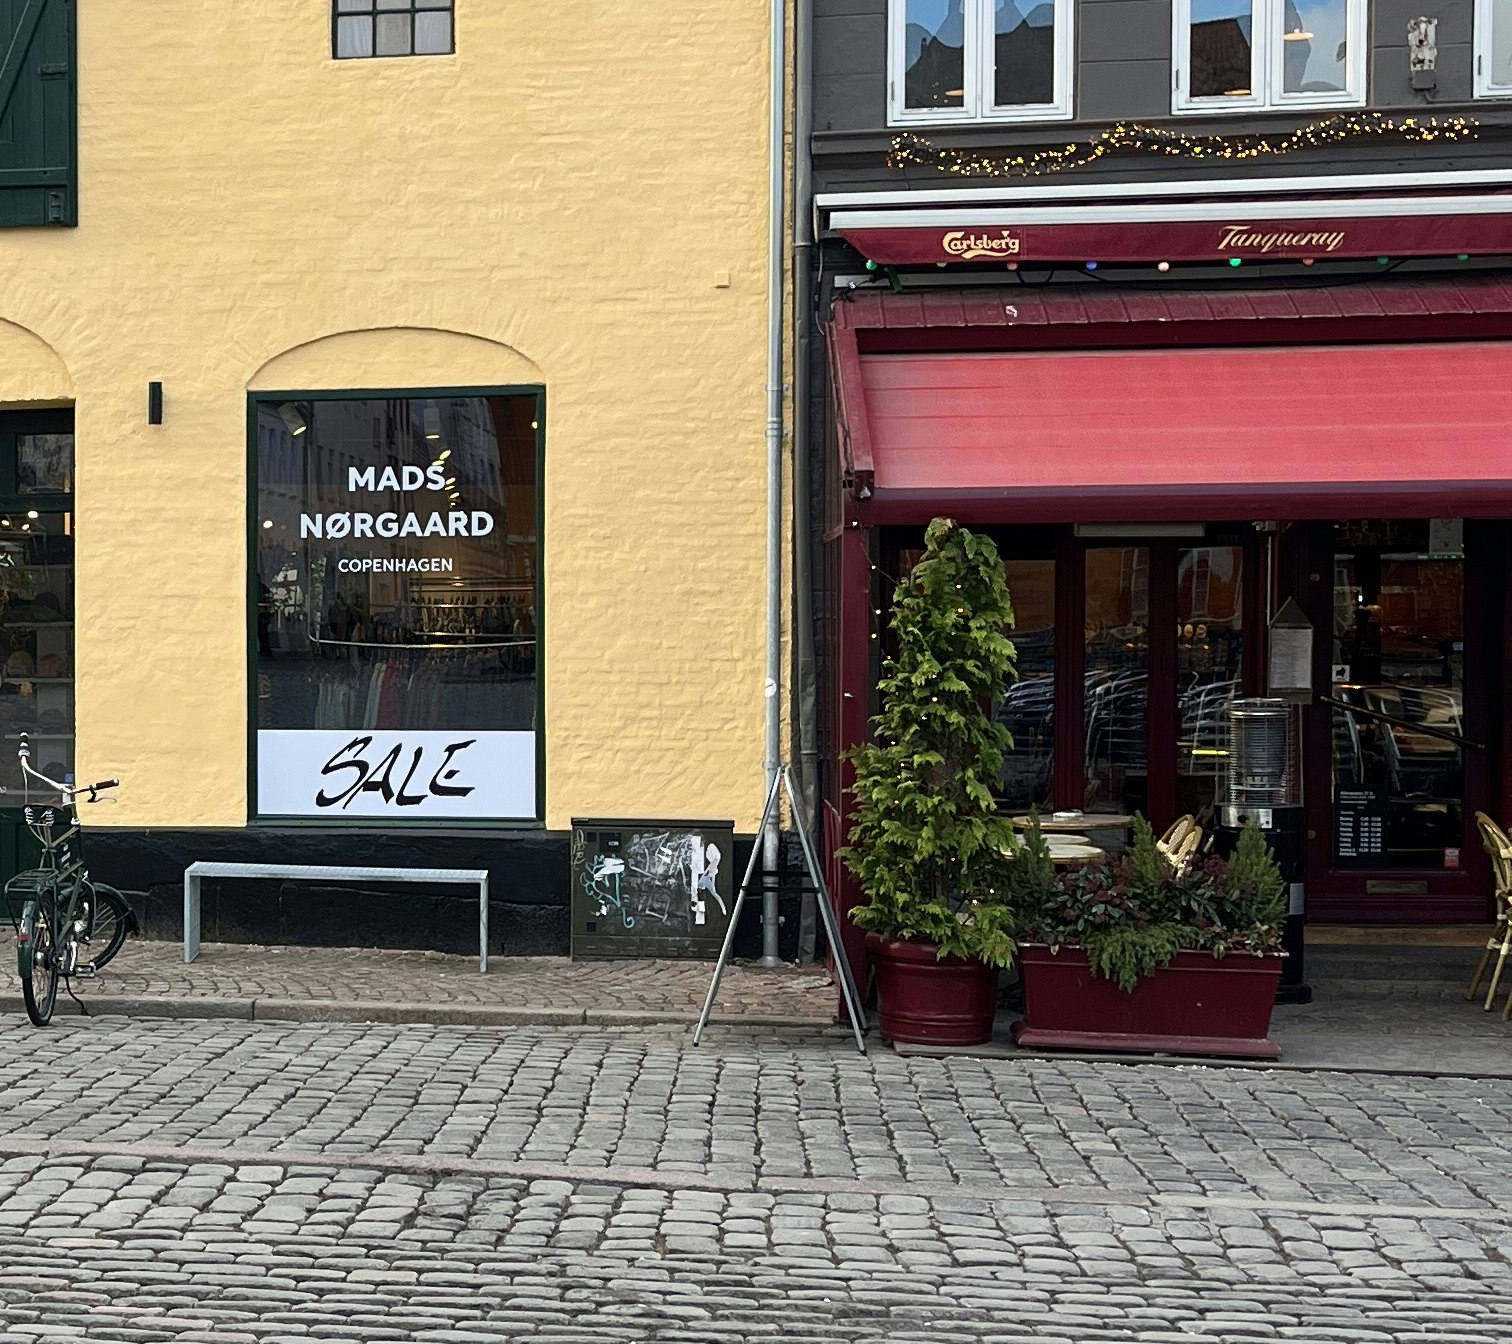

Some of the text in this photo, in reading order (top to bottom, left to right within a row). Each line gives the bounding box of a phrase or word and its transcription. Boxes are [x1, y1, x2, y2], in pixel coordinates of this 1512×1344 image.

[942, 230, 1020, 260] Carlsberg
[1217, 225, 1345, 253] Tanqueray
[348, 465, 445, 492] MADS
[299, 510, 494, 540] NØRGAARD
[338, 557, 453, 573] COPENHAGEN
[315, 735, 477, 809] SALE
